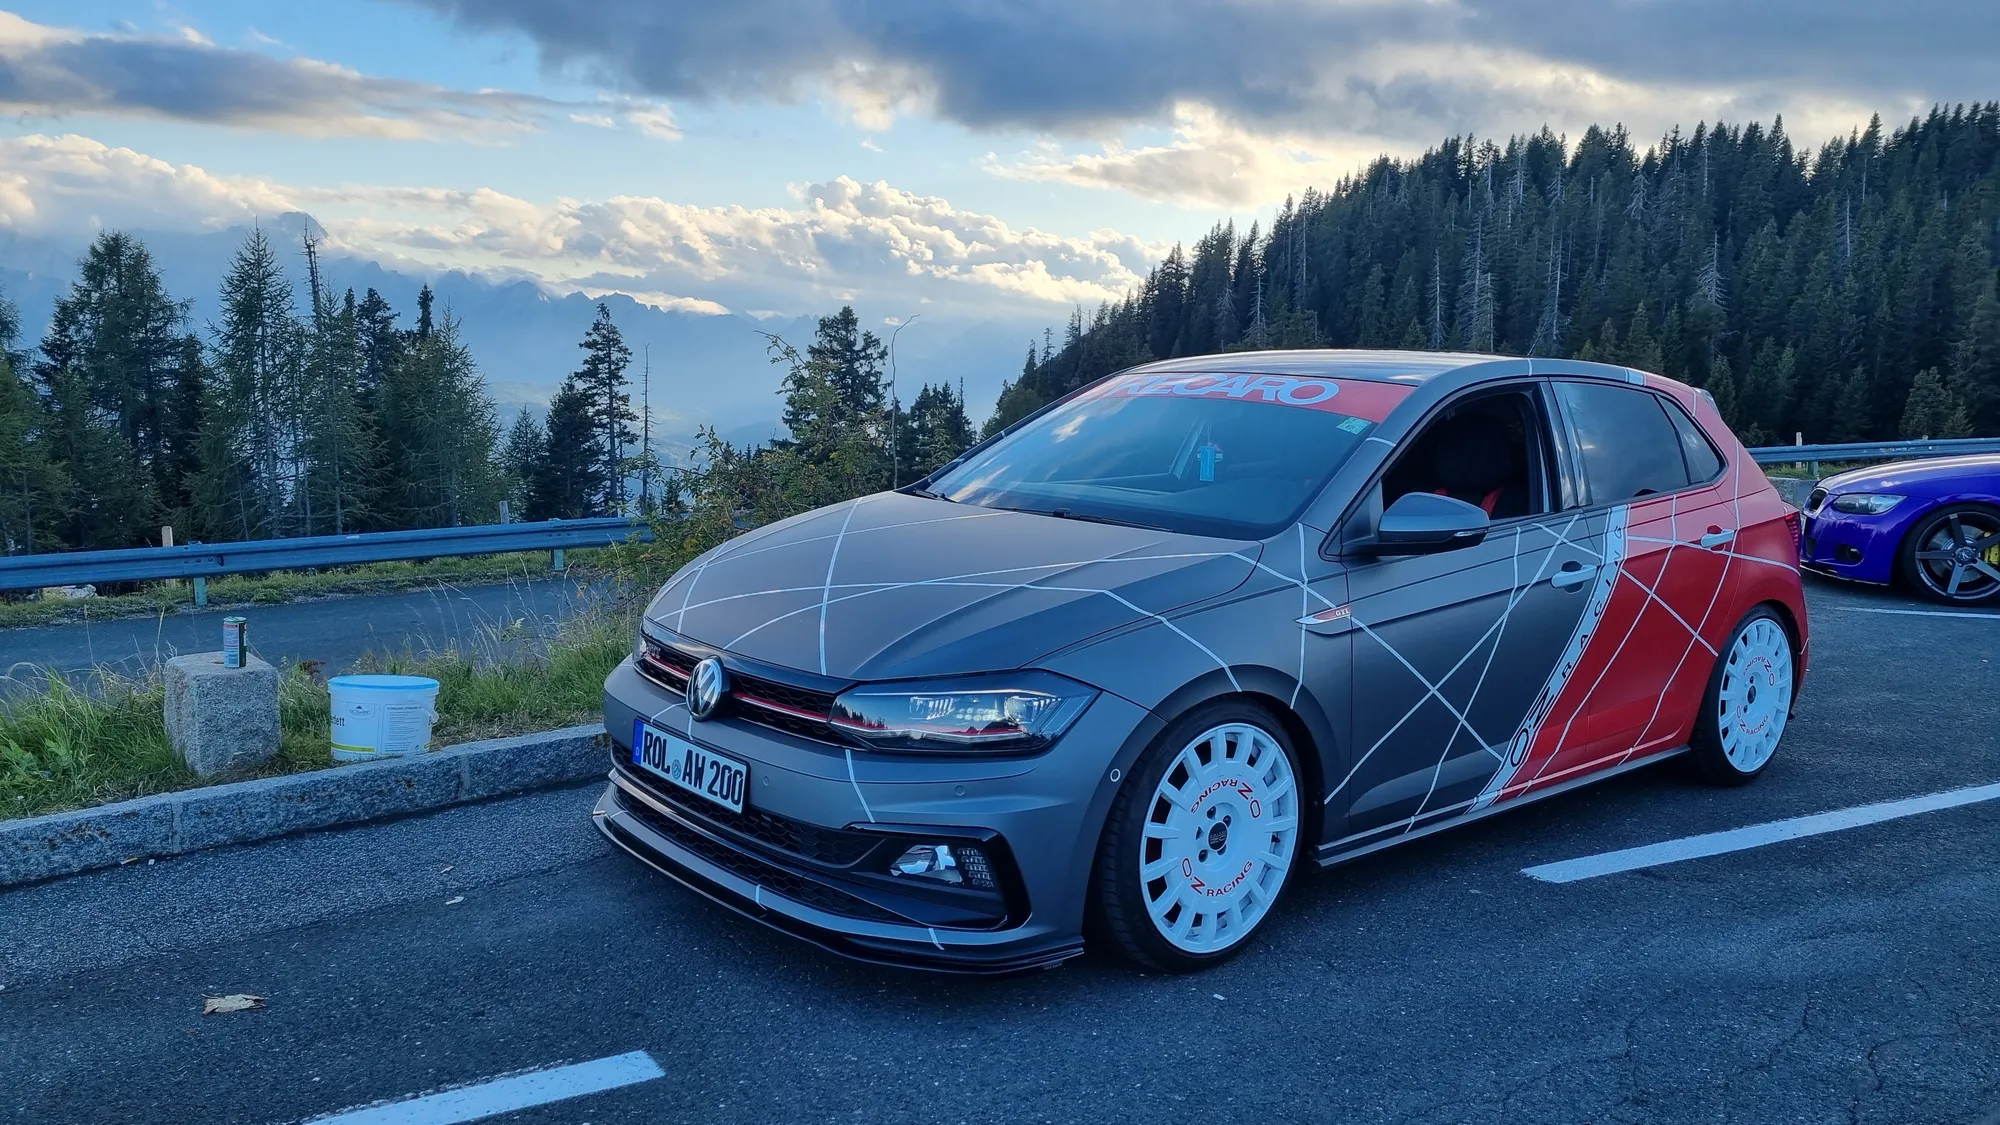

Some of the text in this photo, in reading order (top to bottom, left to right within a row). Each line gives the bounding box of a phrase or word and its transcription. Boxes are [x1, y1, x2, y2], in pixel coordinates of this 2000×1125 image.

[1107, 373, 1340, 405] RECARO
[642, 730, 744, 805] ROL AW 200
[1190, 778, 1238, 814] RACING
[1206, 861, 1253, 897] RACING
